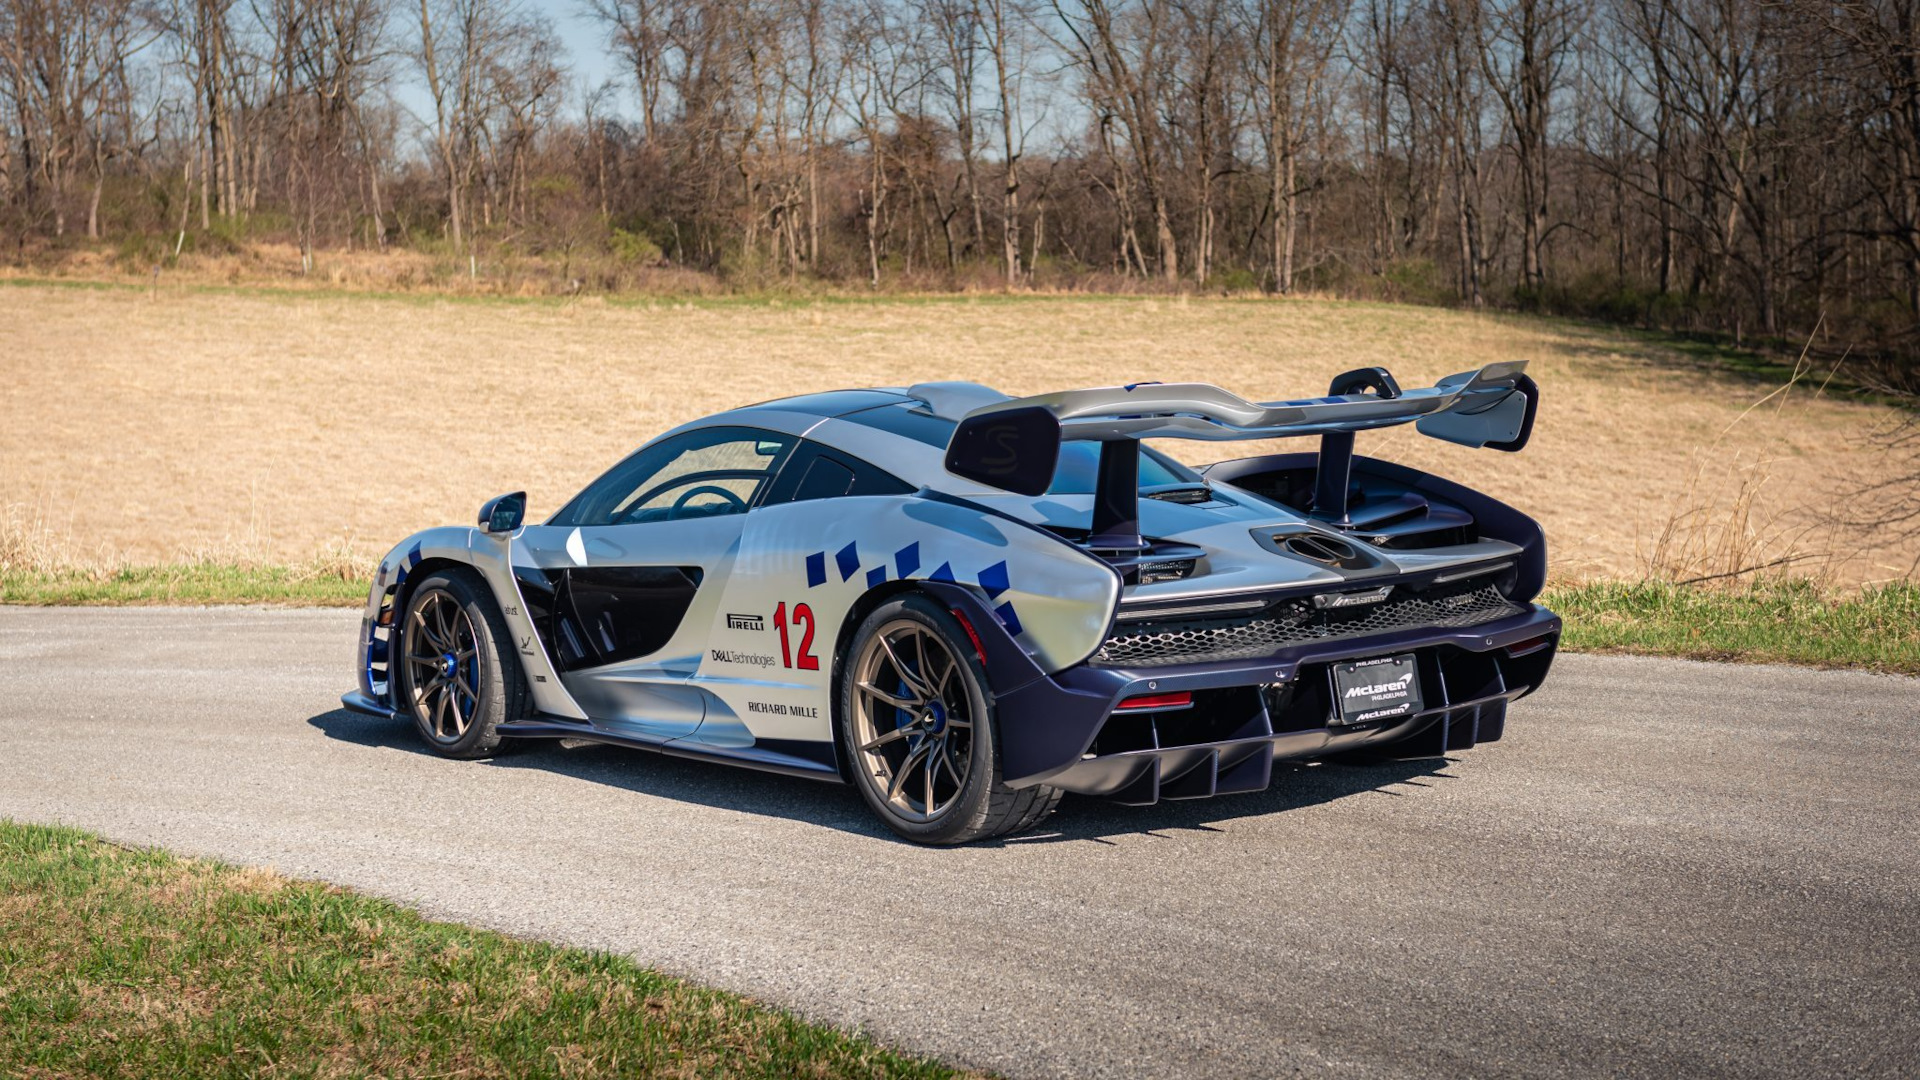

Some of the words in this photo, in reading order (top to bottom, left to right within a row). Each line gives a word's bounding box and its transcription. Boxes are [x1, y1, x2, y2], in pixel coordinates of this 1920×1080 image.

[1332, 594, 1386, 607] McLaren
[726, 613, 764, 631] PIRELLI
[773, 601, 820, 671] 12
[731, 651, 776, 669] Technologies
[1355, 657, 1393, 668] PHILADELPHIA
[1345, 680, 1407, 698] McLaren
[1371, 690, 1408, 702] PHILADELPHIA
[748, 701, 787, 715] RICHARD
[789, 705, 818, 719] MILLE
[1355, 707, 1405, 722] McLaren
